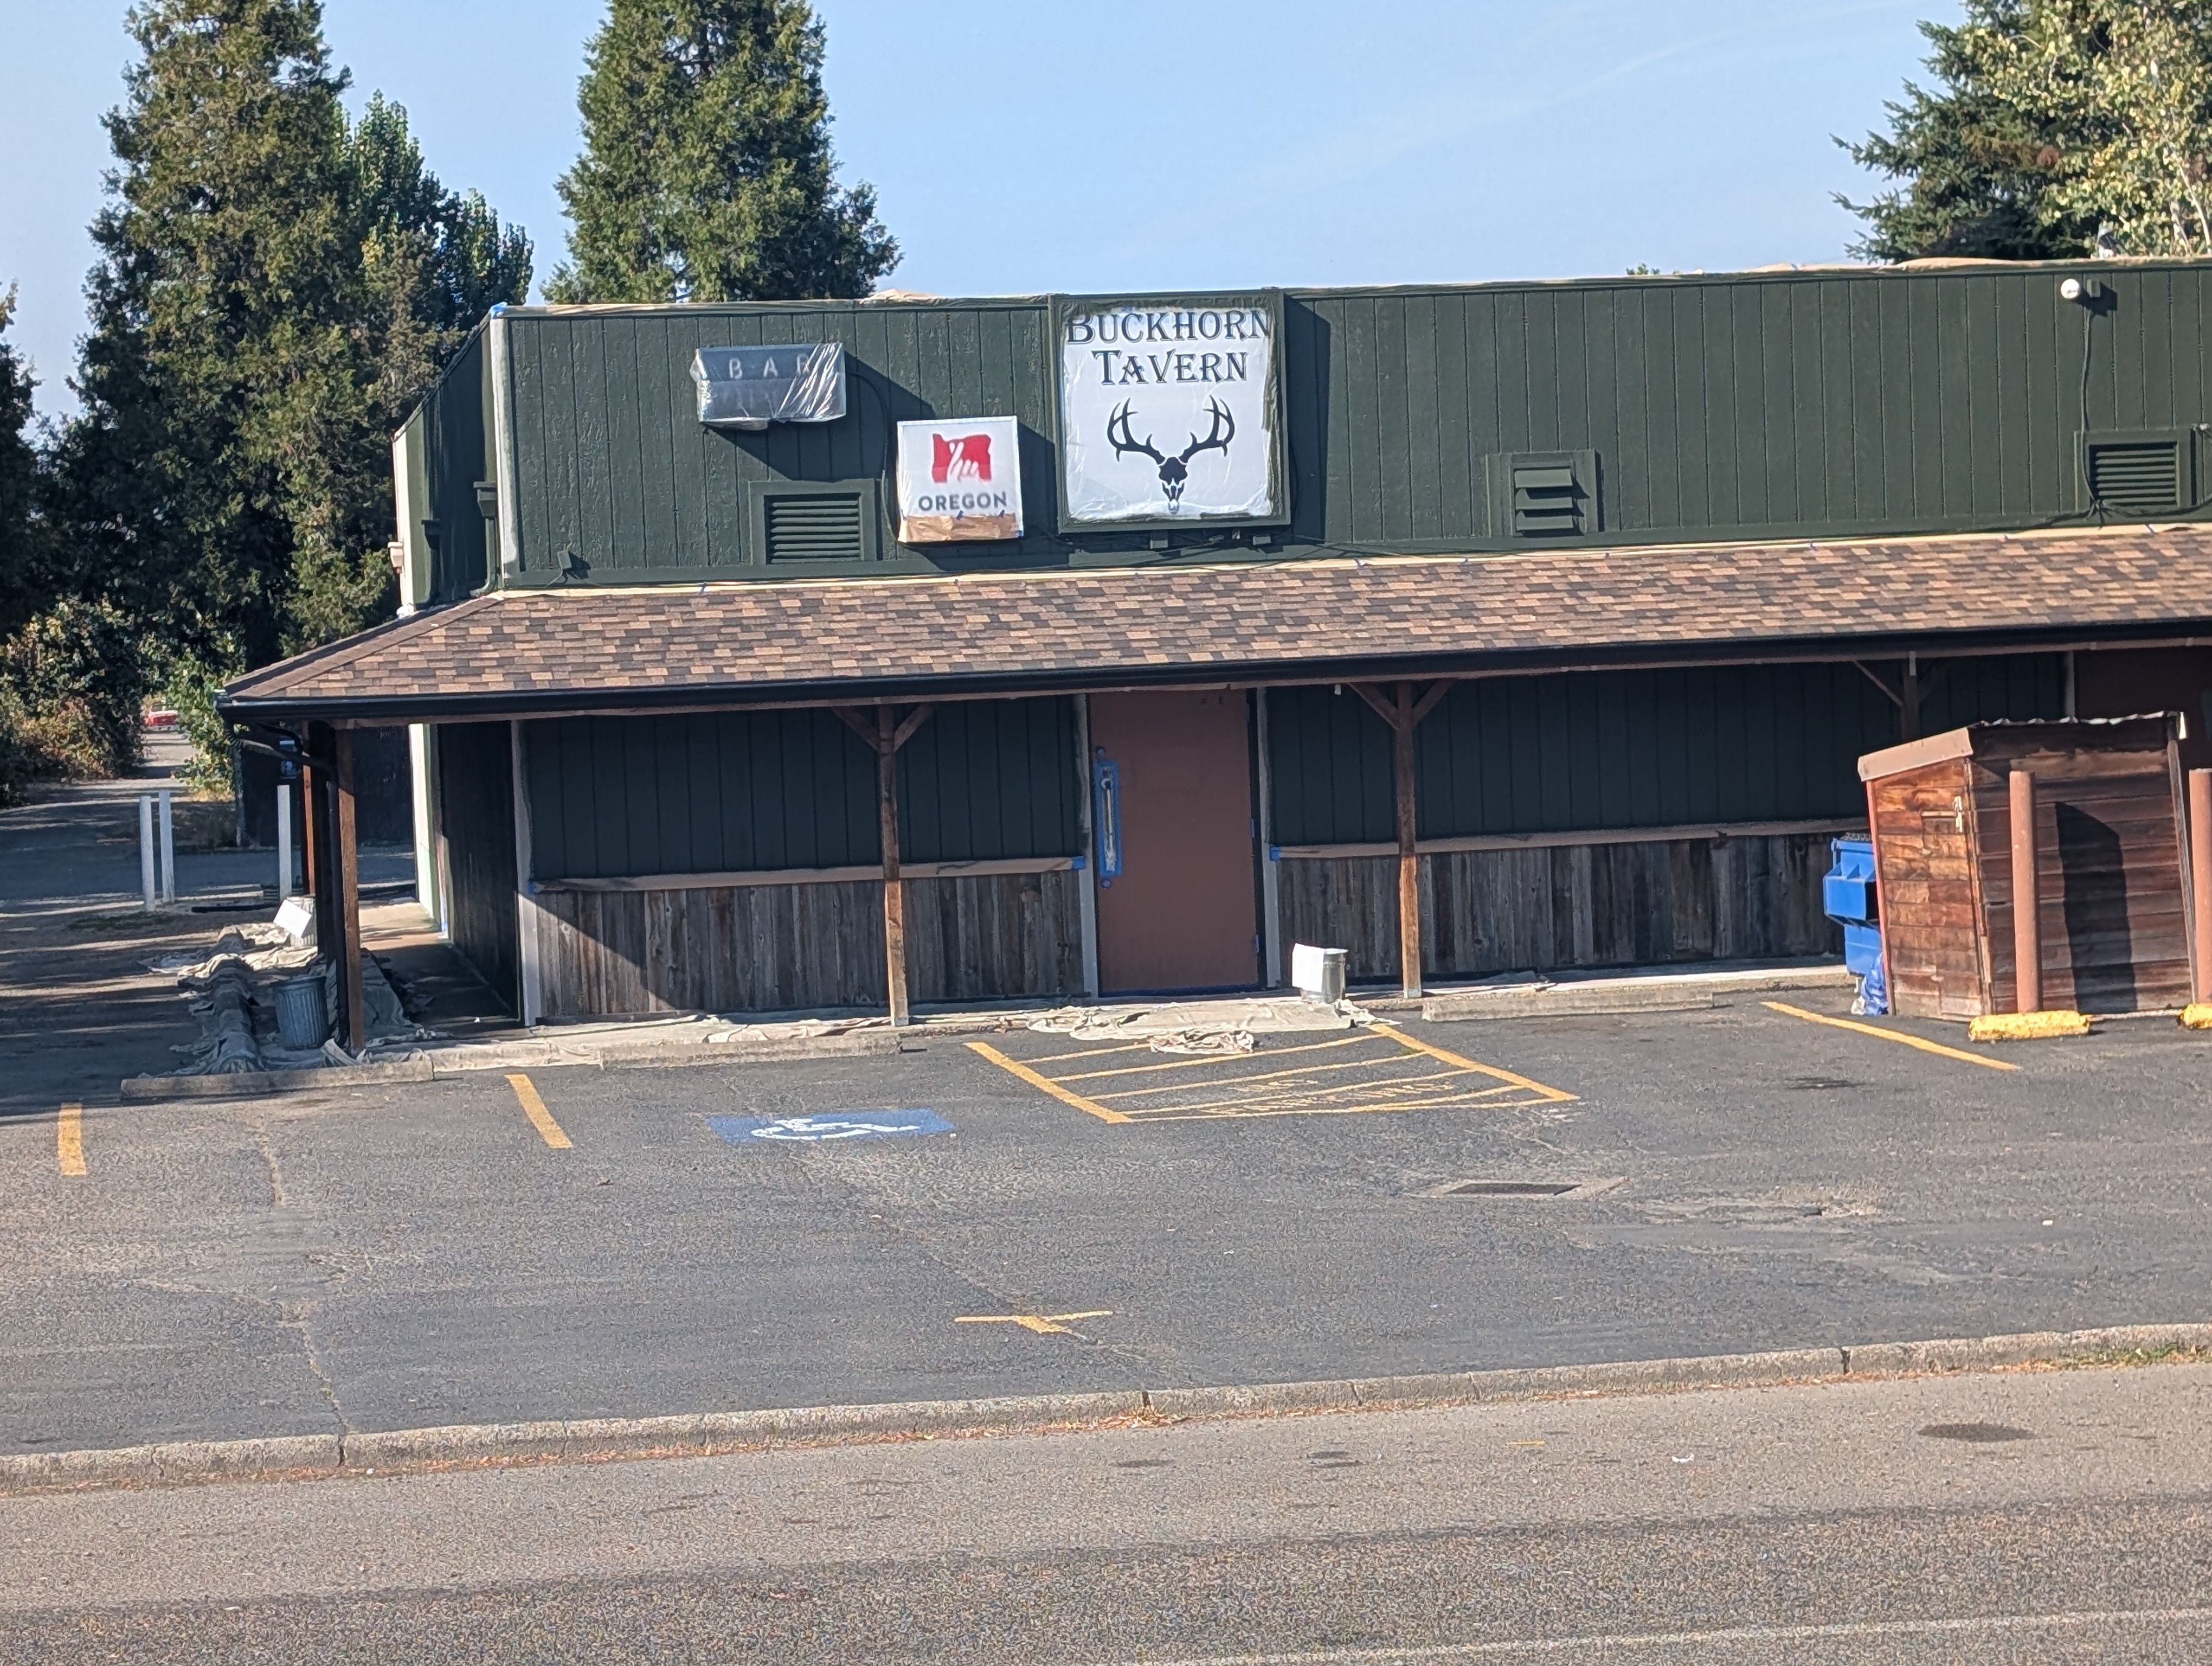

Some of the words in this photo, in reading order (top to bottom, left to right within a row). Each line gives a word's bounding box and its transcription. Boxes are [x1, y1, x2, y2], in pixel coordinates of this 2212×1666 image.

[1067, 310, 1270, 345] BUCKHORN
[728, 354, 810, 380] BAR
[1091, 348, 1249, 386] TAVERN
[918, 491, 1007, 512] OREGON
